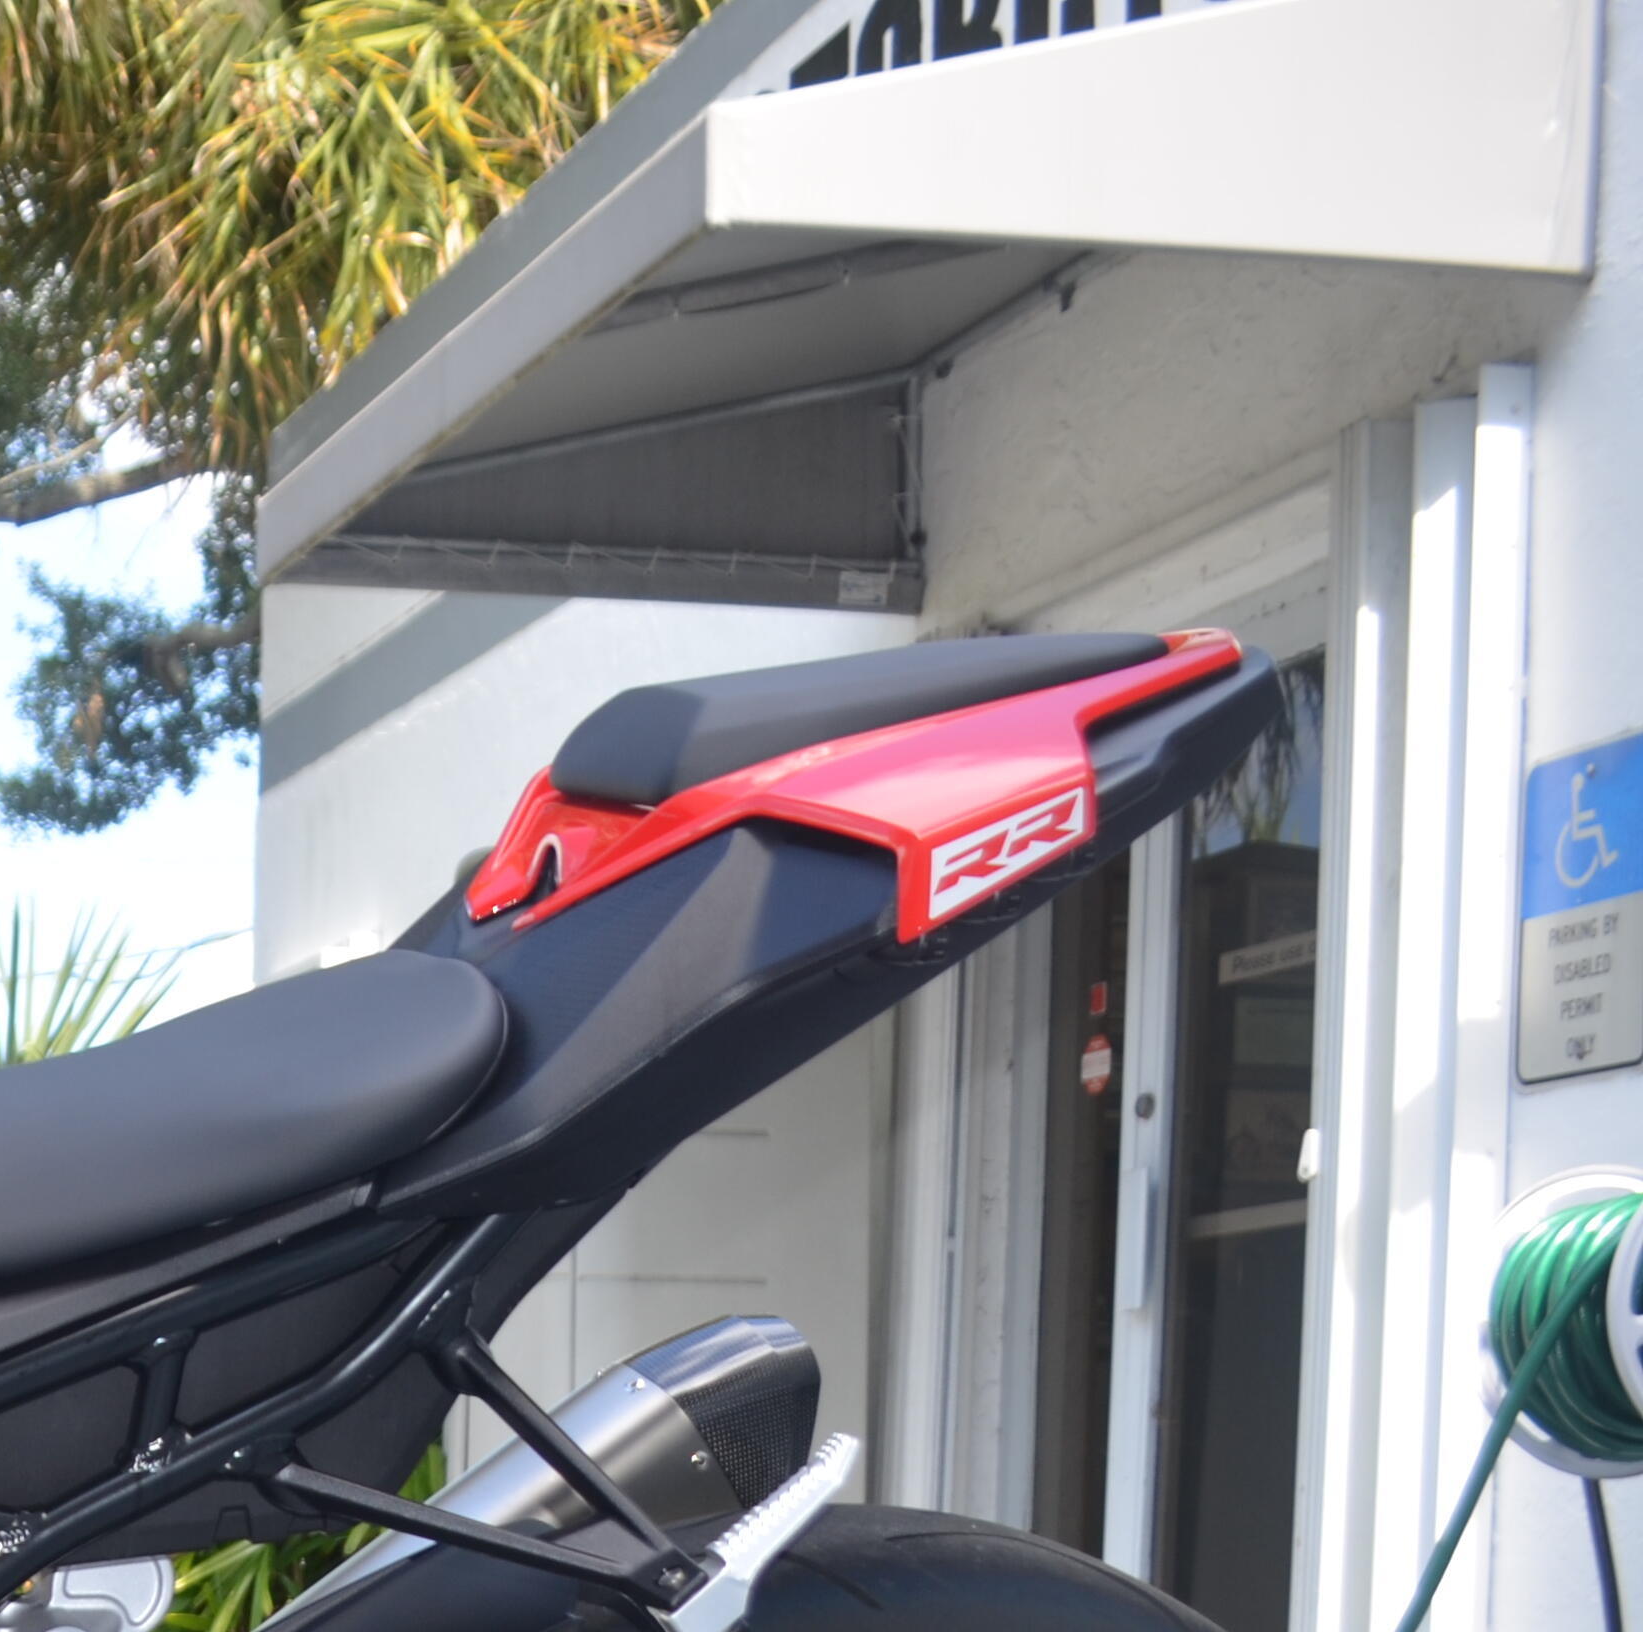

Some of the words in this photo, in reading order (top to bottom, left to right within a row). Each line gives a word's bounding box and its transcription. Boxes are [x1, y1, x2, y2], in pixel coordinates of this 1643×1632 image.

[933, 794, 1079, 896] RR
[1548, 918, 1597, 948] PARKING
[1602, 912, 1620, 936] BY
[1554, 952, 1612, 985] DISABLED
[1560, 992, 1604, 1021] PERMIT
[1565, 1033, 1597, 1060] ONLY
